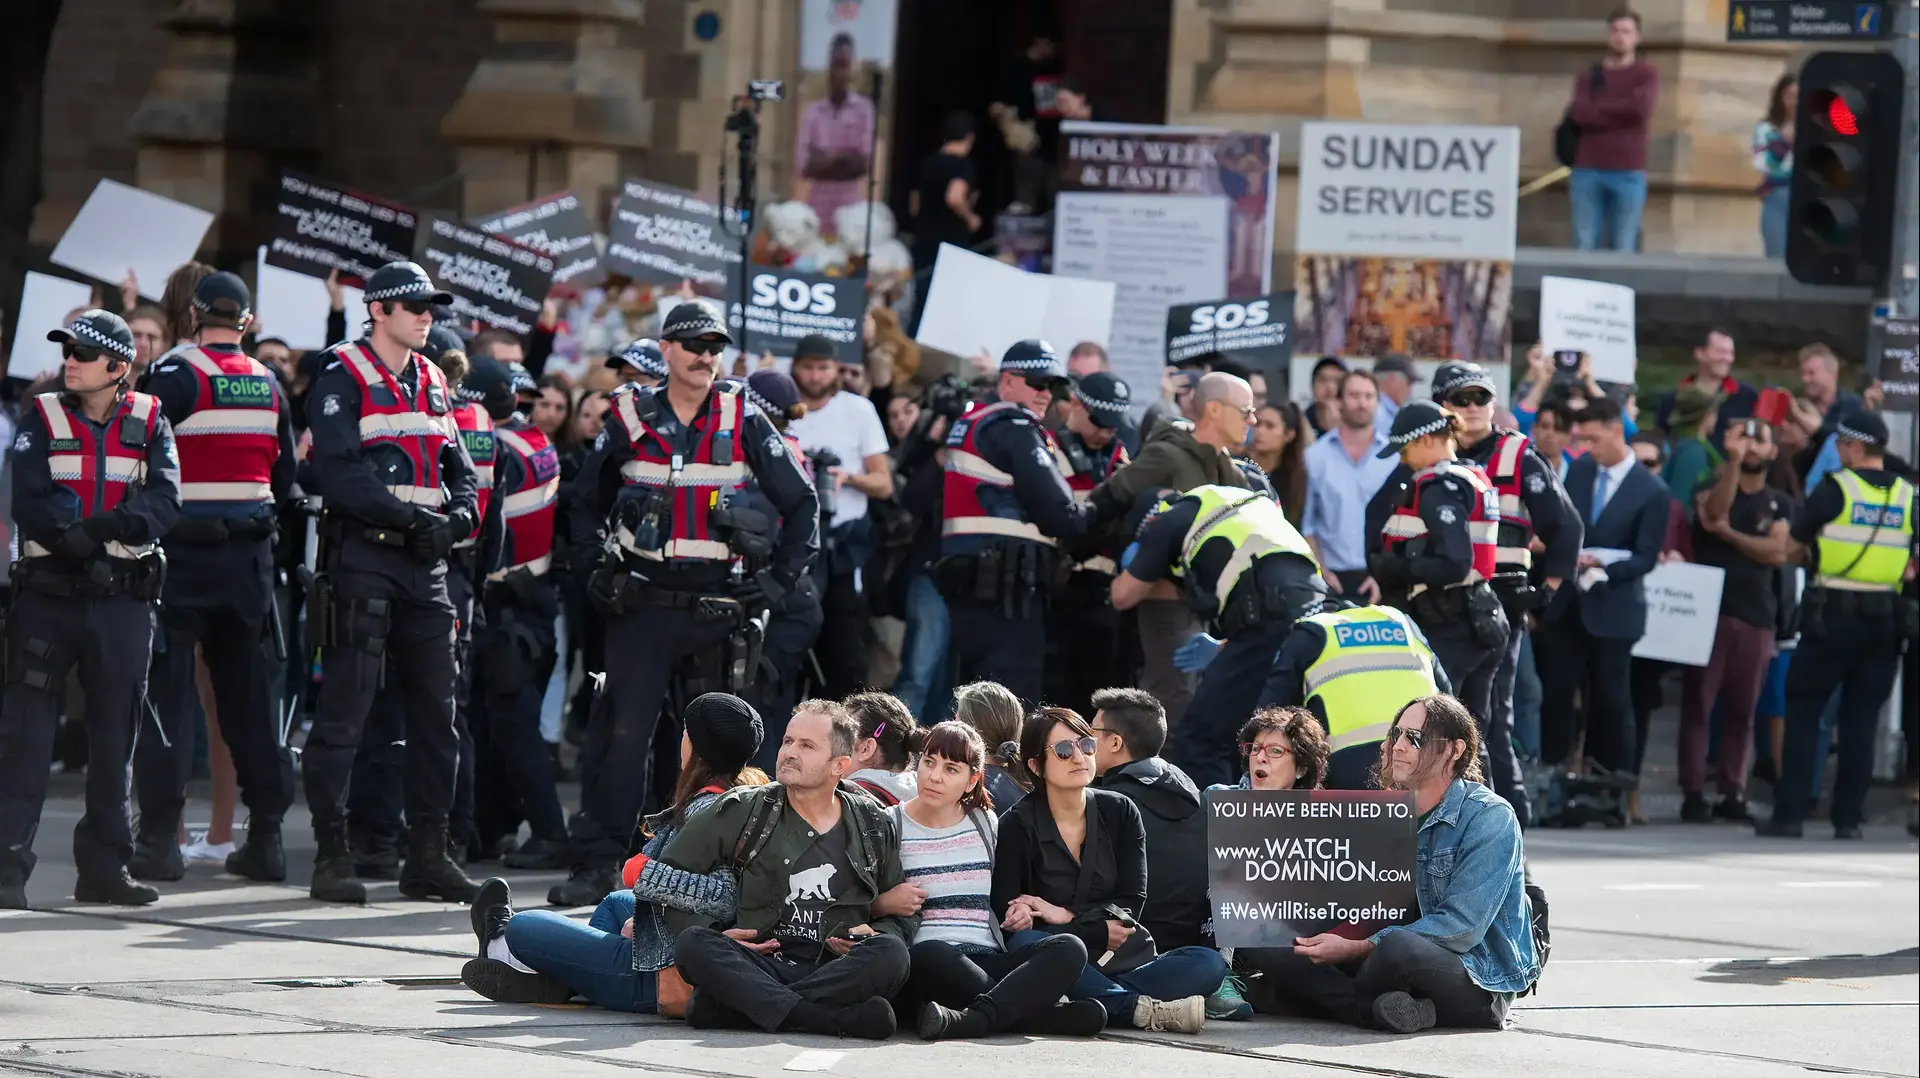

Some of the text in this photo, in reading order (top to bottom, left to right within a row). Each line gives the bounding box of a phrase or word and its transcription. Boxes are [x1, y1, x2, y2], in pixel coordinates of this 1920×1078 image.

[1068, 137, 1217, 166] HOLY WEEK
[1322, 134, 1497, 172] SUNDAY
[1080, 164, 1204, 192] & EASTER
[1318, 185, 1496, 219] SERVICES
[752, 274, 836, 315] SOS
[780, 311, 857, 330] EMERGENCY
[1189, 300, 1270, 333] SOS
[1215, 333, 1287, 352] EMERGENCY
[216, 377, 271, 396] Police
[464, 432, 493, 450] lice
[1854, 505, 1903, 525] Polce
[1337, 624, 1406, 645] Police
[1212, 802, 1414, 819] YOU HAVE BEEN LIED TO.
[1215, 838, 1351, 860] www.WATCH
[1220, 901, 1407, 925] #WeWillRiseTogether
